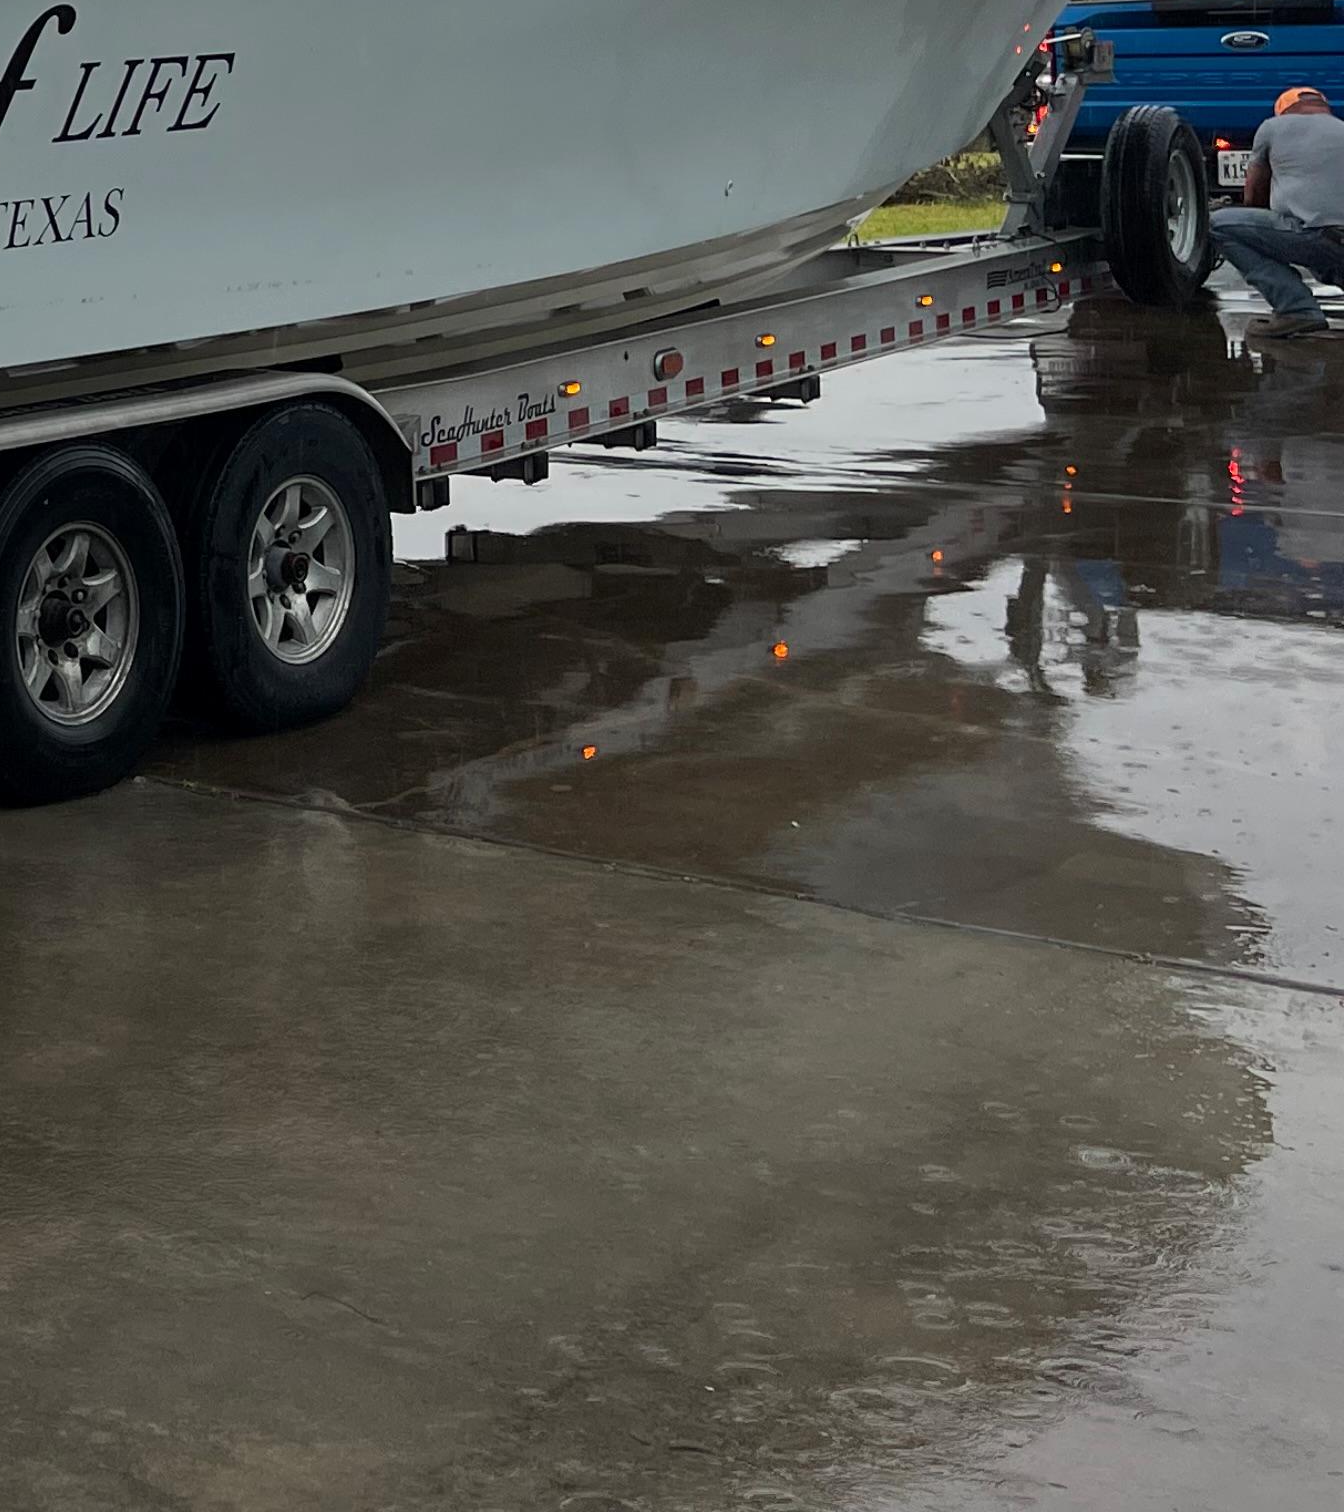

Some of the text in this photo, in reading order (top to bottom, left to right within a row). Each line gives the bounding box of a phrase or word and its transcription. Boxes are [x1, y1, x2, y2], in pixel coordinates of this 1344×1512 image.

[51, 52, 236, 144] LIFE
[420, 392, 557, 447] SeaHunter Boats
